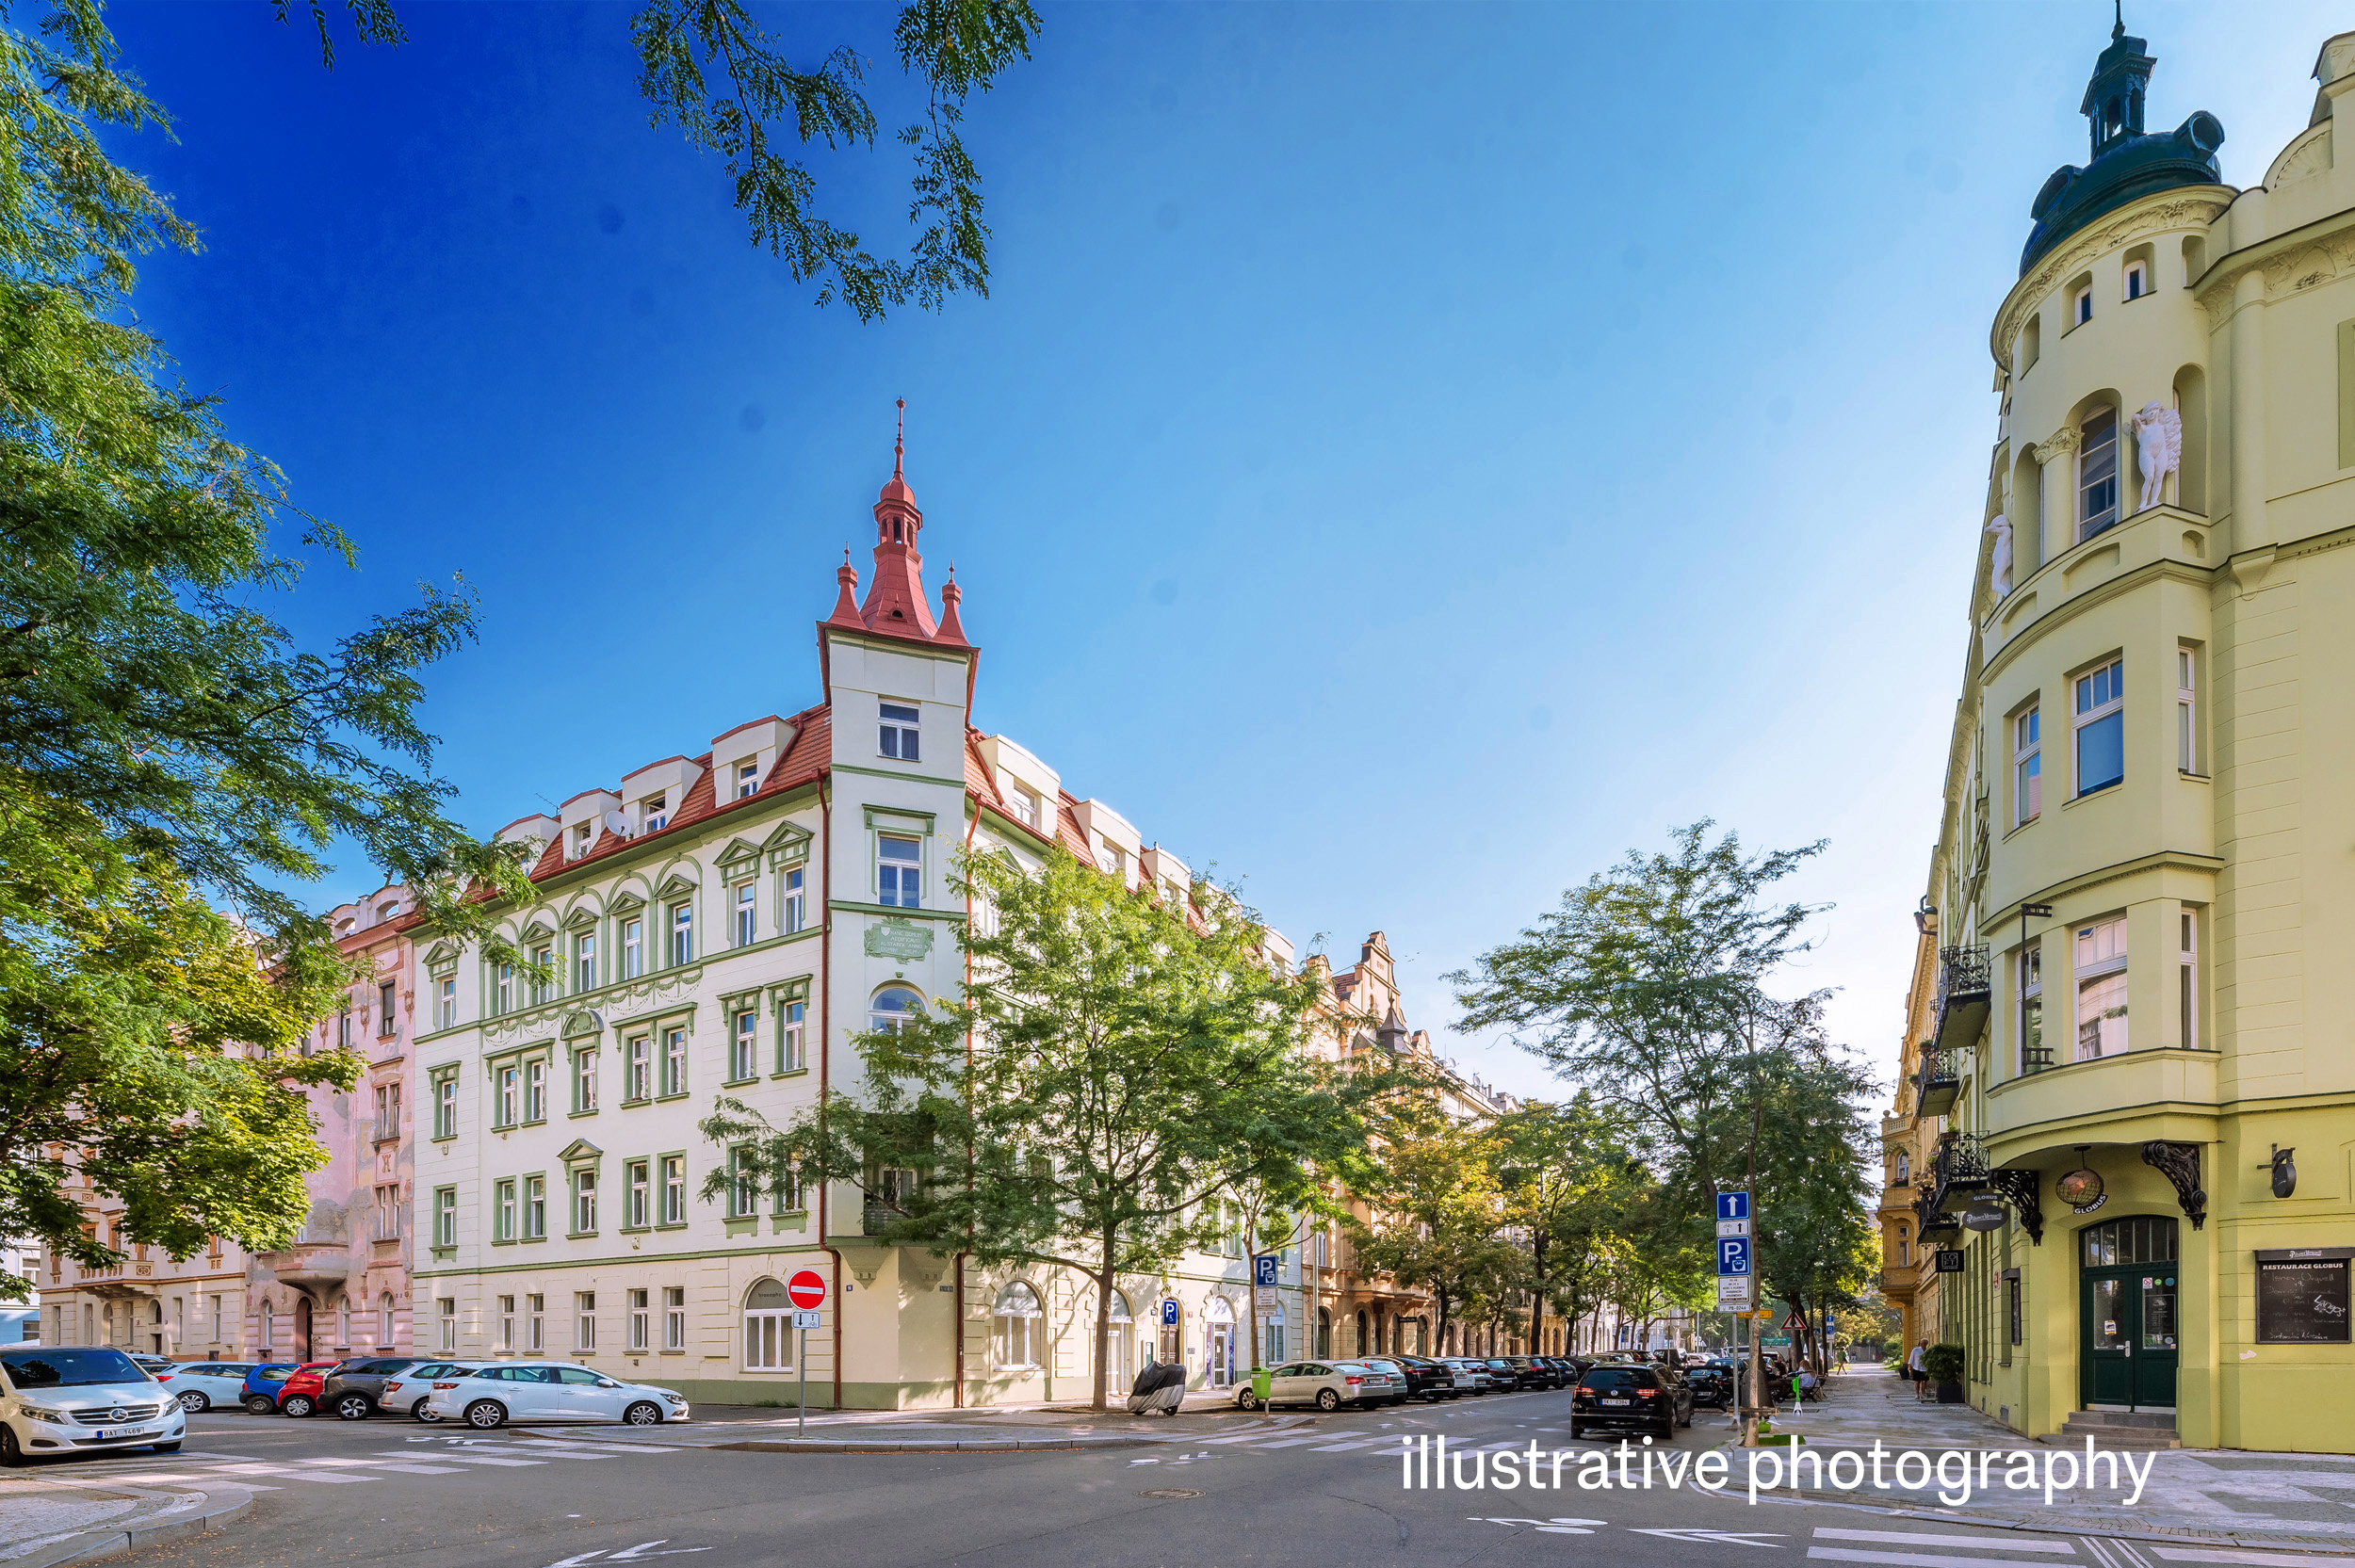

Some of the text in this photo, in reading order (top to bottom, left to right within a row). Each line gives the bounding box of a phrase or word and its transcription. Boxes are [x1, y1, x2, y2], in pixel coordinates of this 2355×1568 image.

[2074, 1195, 2106, 1214] GLOBUS
[1725, 1242, 1742, 1263] P
[1259, 1259, 1273, 1277] P
[1165, 1303, 1175, 1317] P
